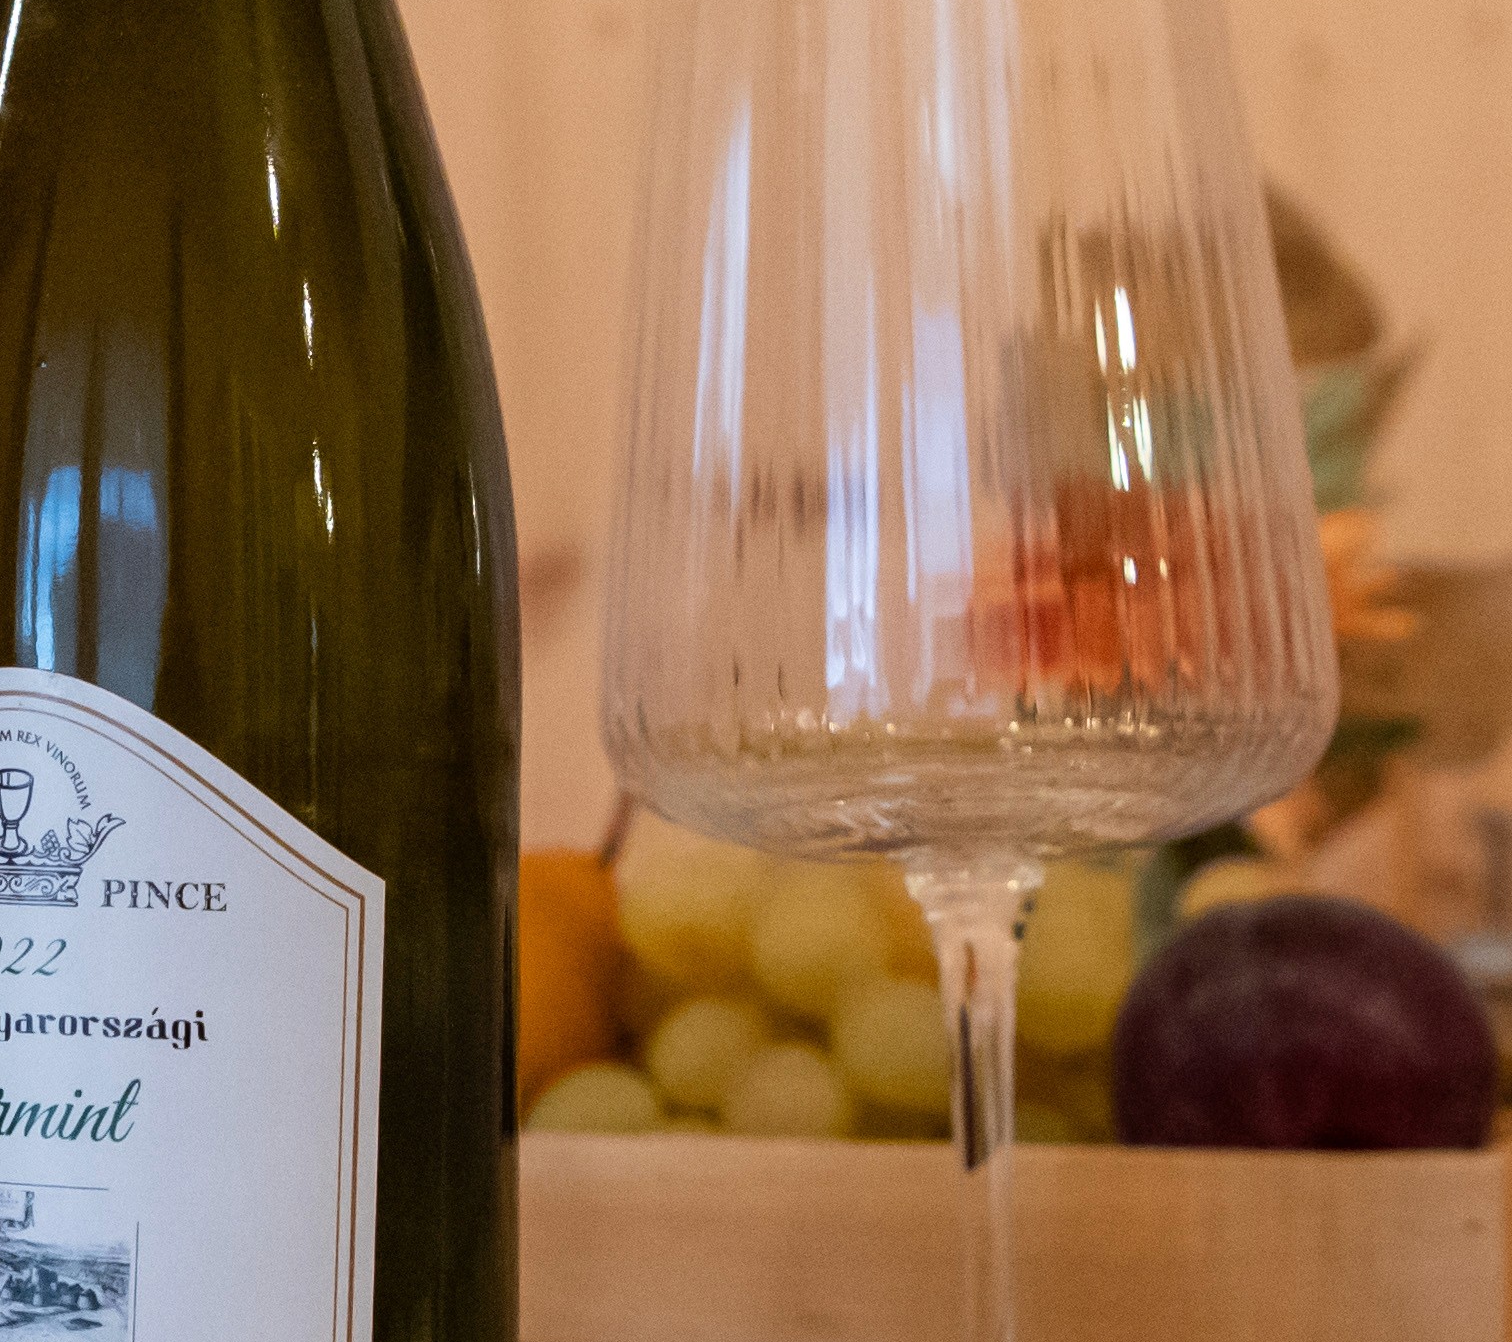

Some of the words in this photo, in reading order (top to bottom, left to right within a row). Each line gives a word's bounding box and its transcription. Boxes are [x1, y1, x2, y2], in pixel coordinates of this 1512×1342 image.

[17, 729, 43, 748] REX
[46, 741, 92, 810] VINORUM
[100, 878, 227, 912] PINCE
